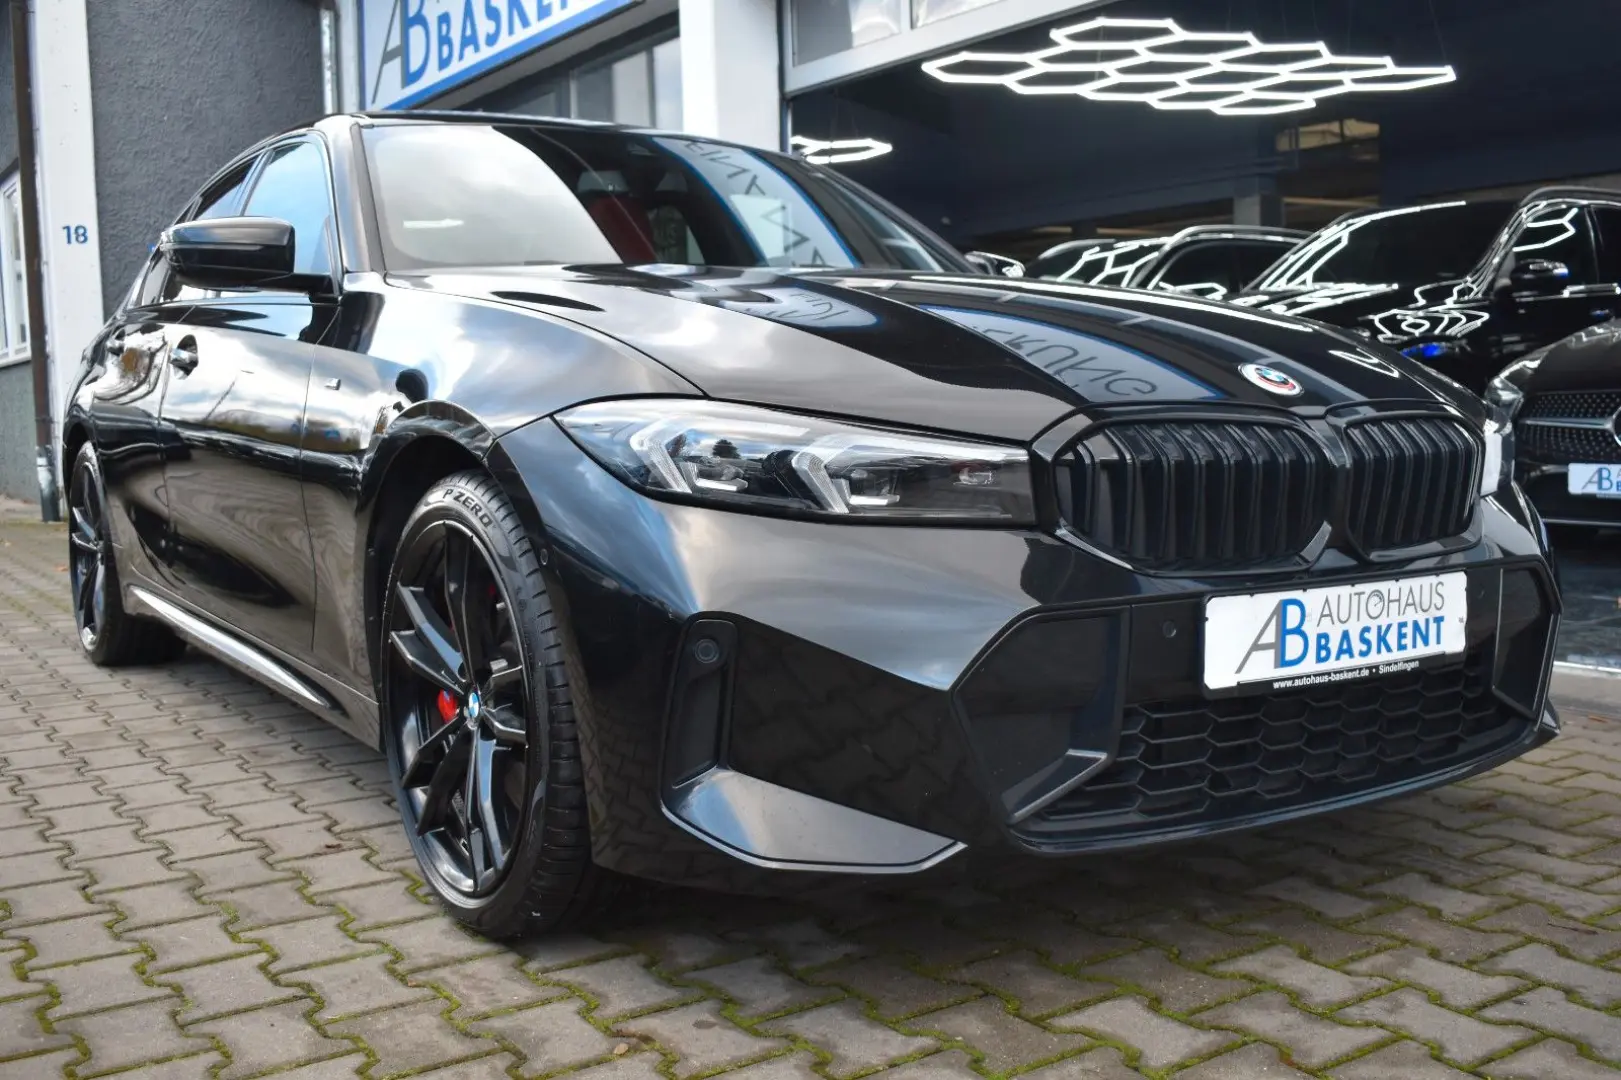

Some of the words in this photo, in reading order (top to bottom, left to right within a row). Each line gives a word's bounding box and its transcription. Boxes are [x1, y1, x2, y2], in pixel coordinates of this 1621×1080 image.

[62, 225, 88, 244] 18
[1581, 467, 1613, 491] AB
[442, 488, 454, 499] P
[453, 491, 493, 527] ZERO
[1316, 581, 1445, 627] AUTOHAUS
[1234, 598, 1310, 674] AB
[1315, 616, 1445, 664] BASKENT
[1273, 668, 1370, 689] www.autohaus-baskent.de
[1378, 660, 1419, 674] Sindelfingen
